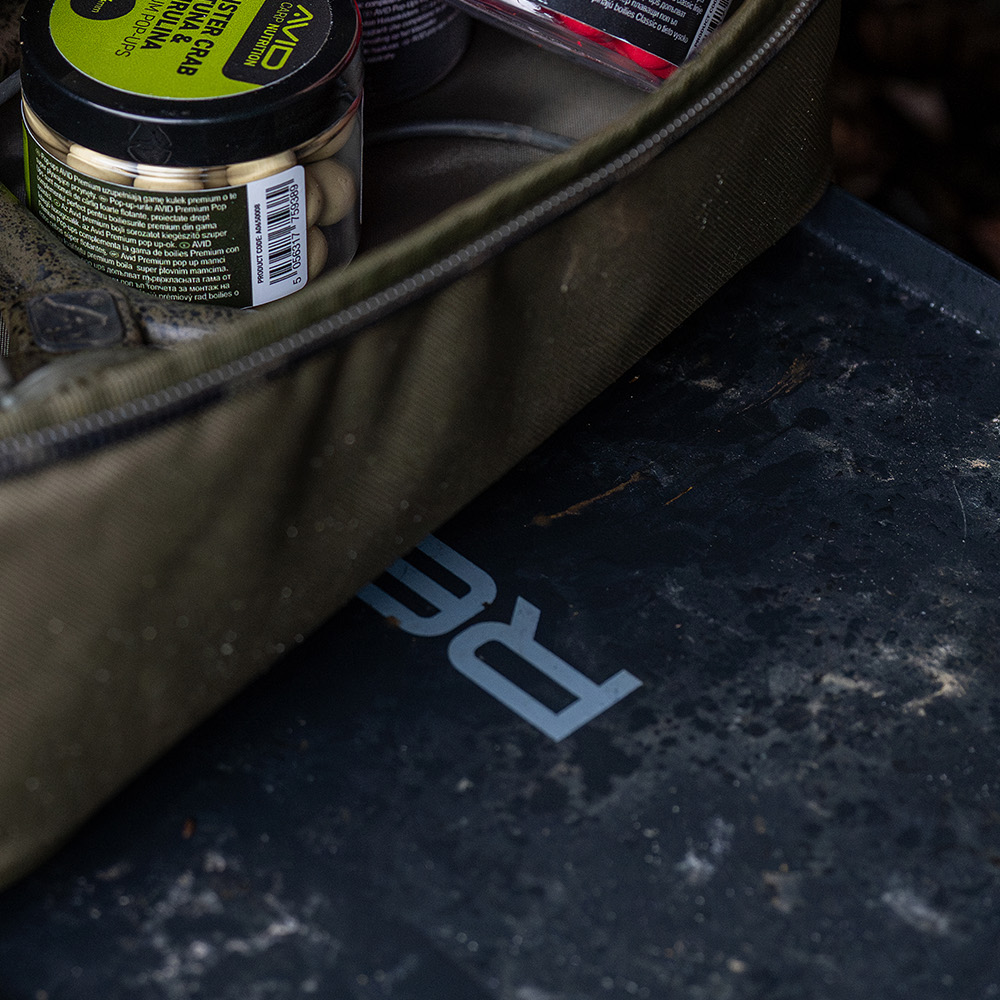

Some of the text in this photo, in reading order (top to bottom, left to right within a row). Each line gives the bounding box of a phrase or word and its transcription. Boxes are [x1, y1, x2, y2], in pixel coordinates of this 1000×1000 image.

[635, 12, 657, 29] Classic
[115, 12, 151, 58] POP-UPS
[170, 33, 193, 44] &
[243, 1, 293, 68] CARP NUTRITION
[260, 4, 314, 70] AVID
[177, 38, 215, 76] CRAB
[74, 174, 101, 192] Premium
[188, 195, 221, 205] premium
[175, 204, 209, 213] Premium
[211, 203, 227, 211] Pop
[147, 222, 180, 230] premium
[195, 223, 217, 231] gama
[289, 183, 302, 285] 5 056317 759389
[105, 231, 137, 244] Premium
[138, 239, 152, 247] pop
[192, 239, 212, 248] AVID
[121, 252, 136, 262] Avid
[138, 255, 171, 265] Premium
[131, 247, 151, 255] gama
[152, 248, 163, 256] de
[190, 248, 224, 257] Premium
[226, 246, 240, 254] con
[136, 265, 157, 273] super
[190, 266, 229, 274] mamcima.
